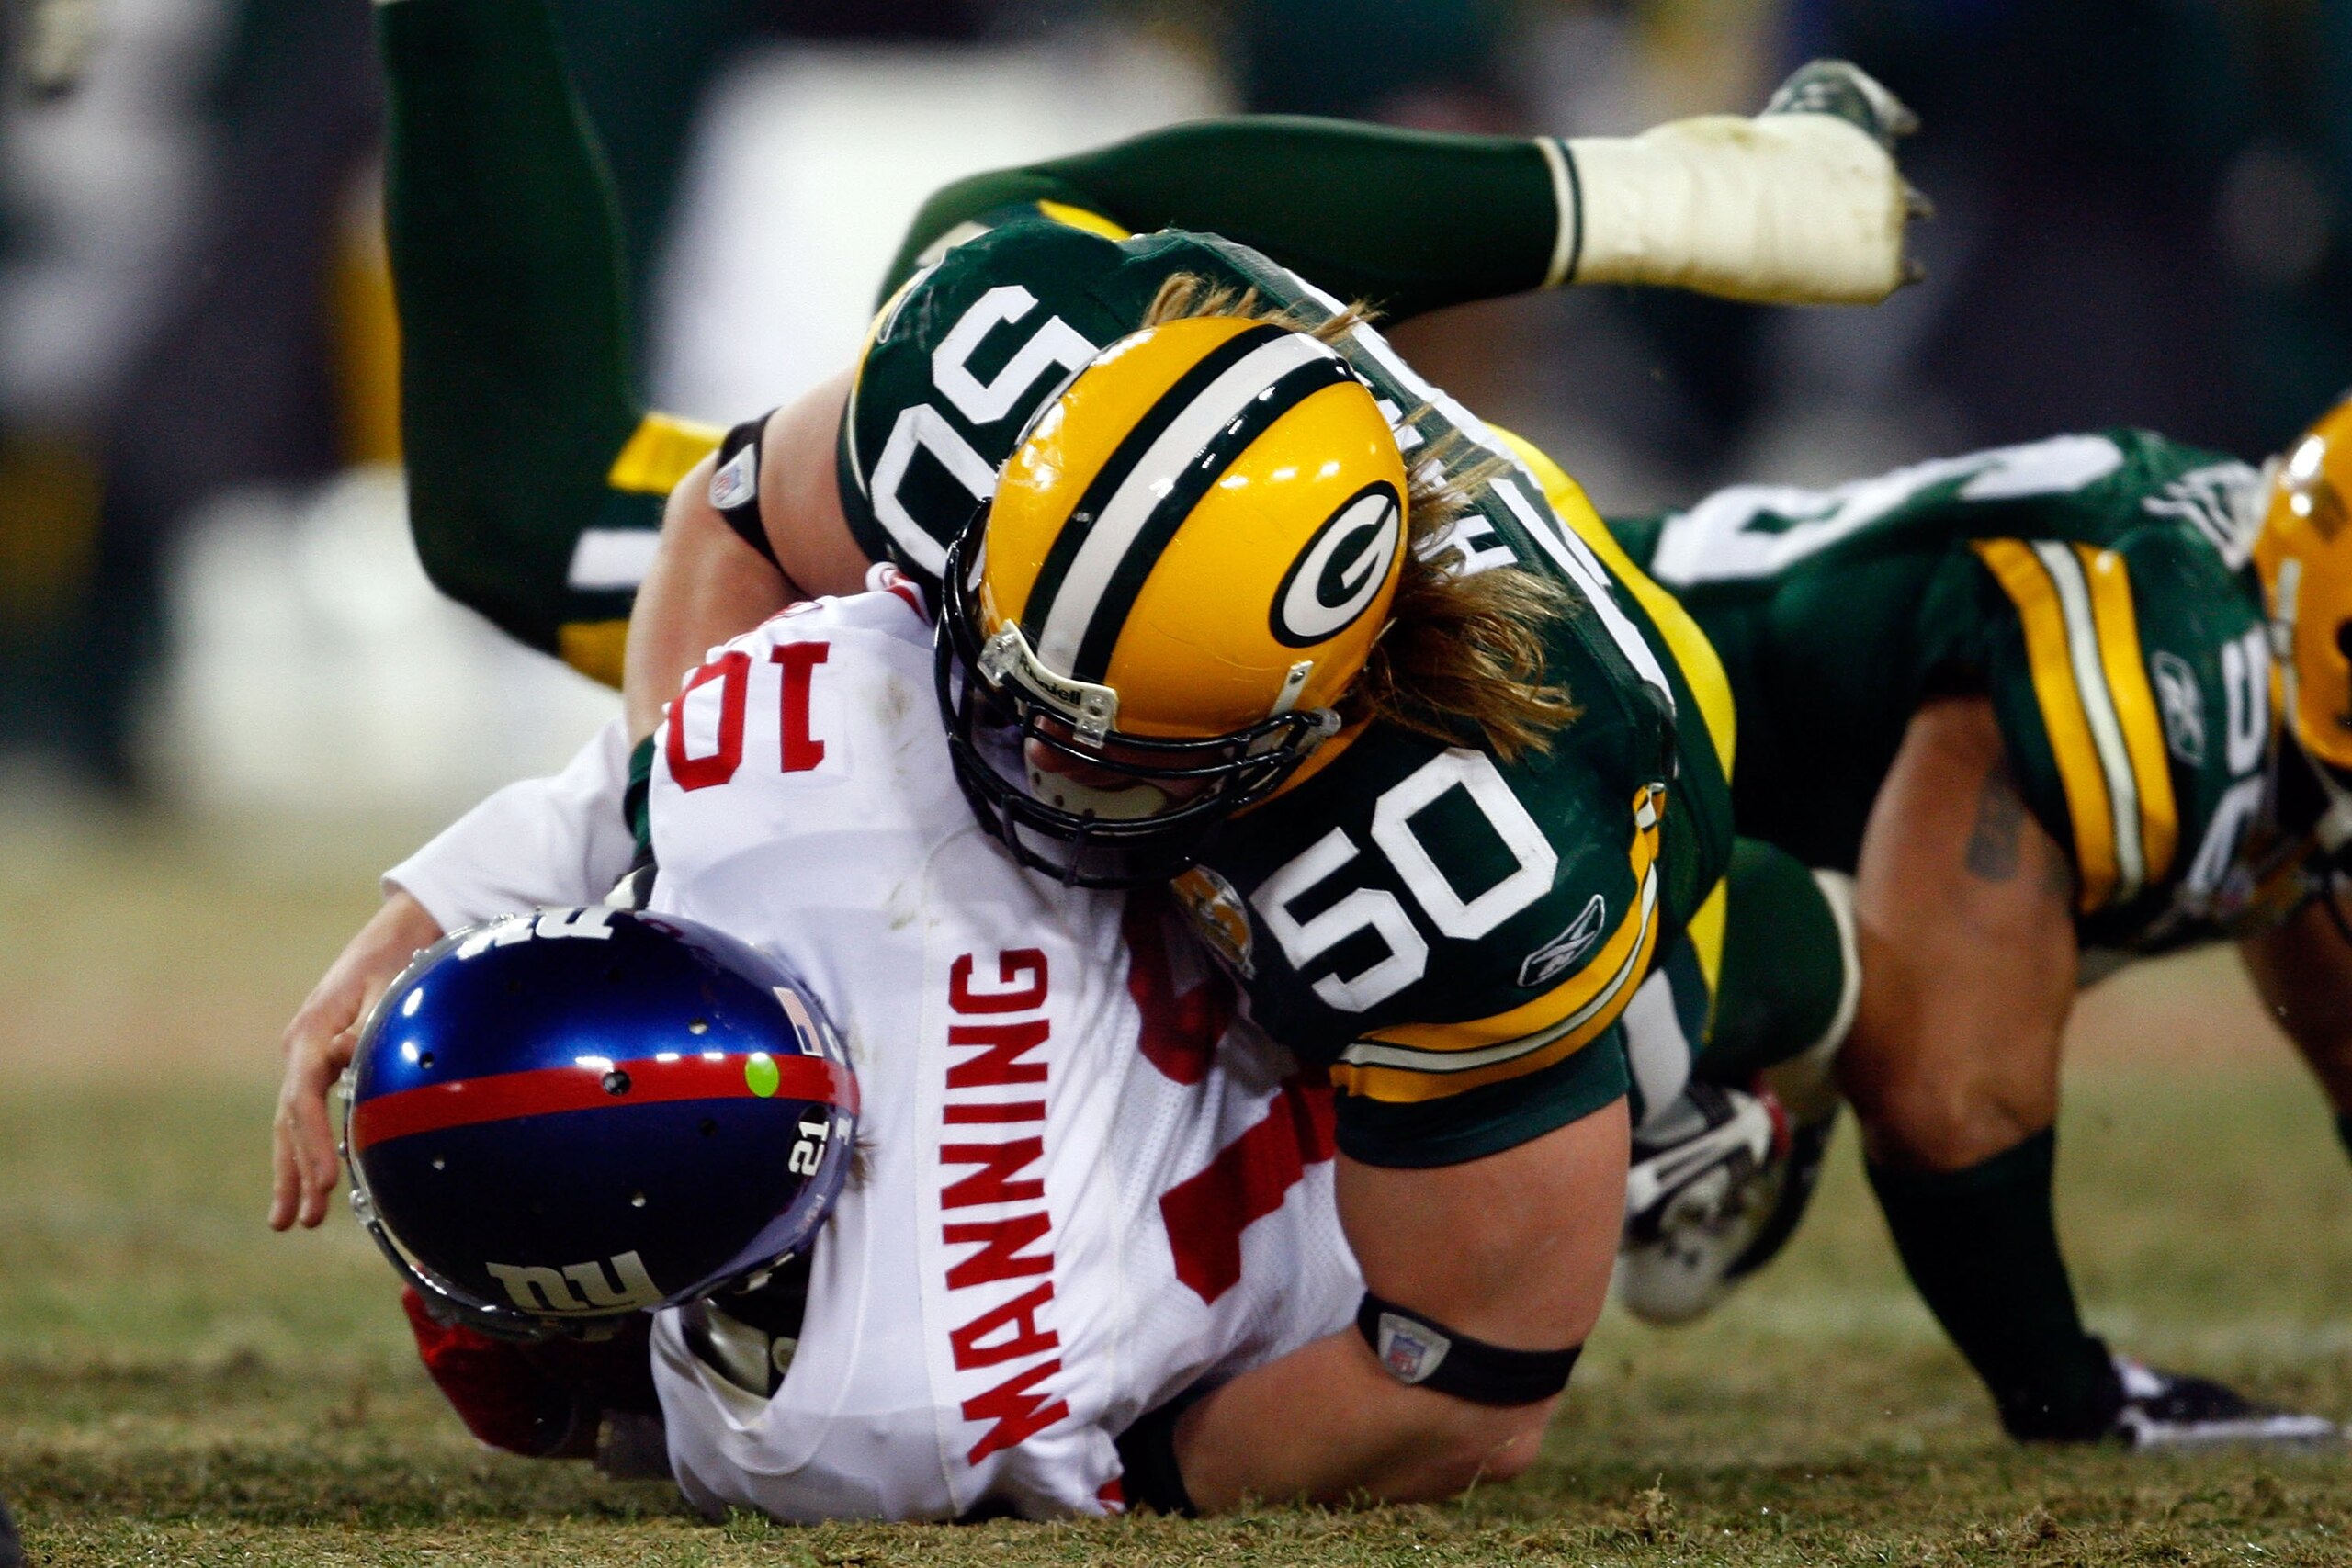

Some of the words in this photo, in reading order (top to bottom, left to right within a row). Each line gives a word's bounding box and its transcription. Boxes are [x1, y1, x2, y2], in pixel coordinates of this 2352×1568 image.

[1283, 493, 1398, 637] G
[665, 641, 831, 793] 10
[1250, 747, 1559, 1012] 50
[788, 1121, 830, 1177] 21
[938, 947, 1070, 1467] MANNING
